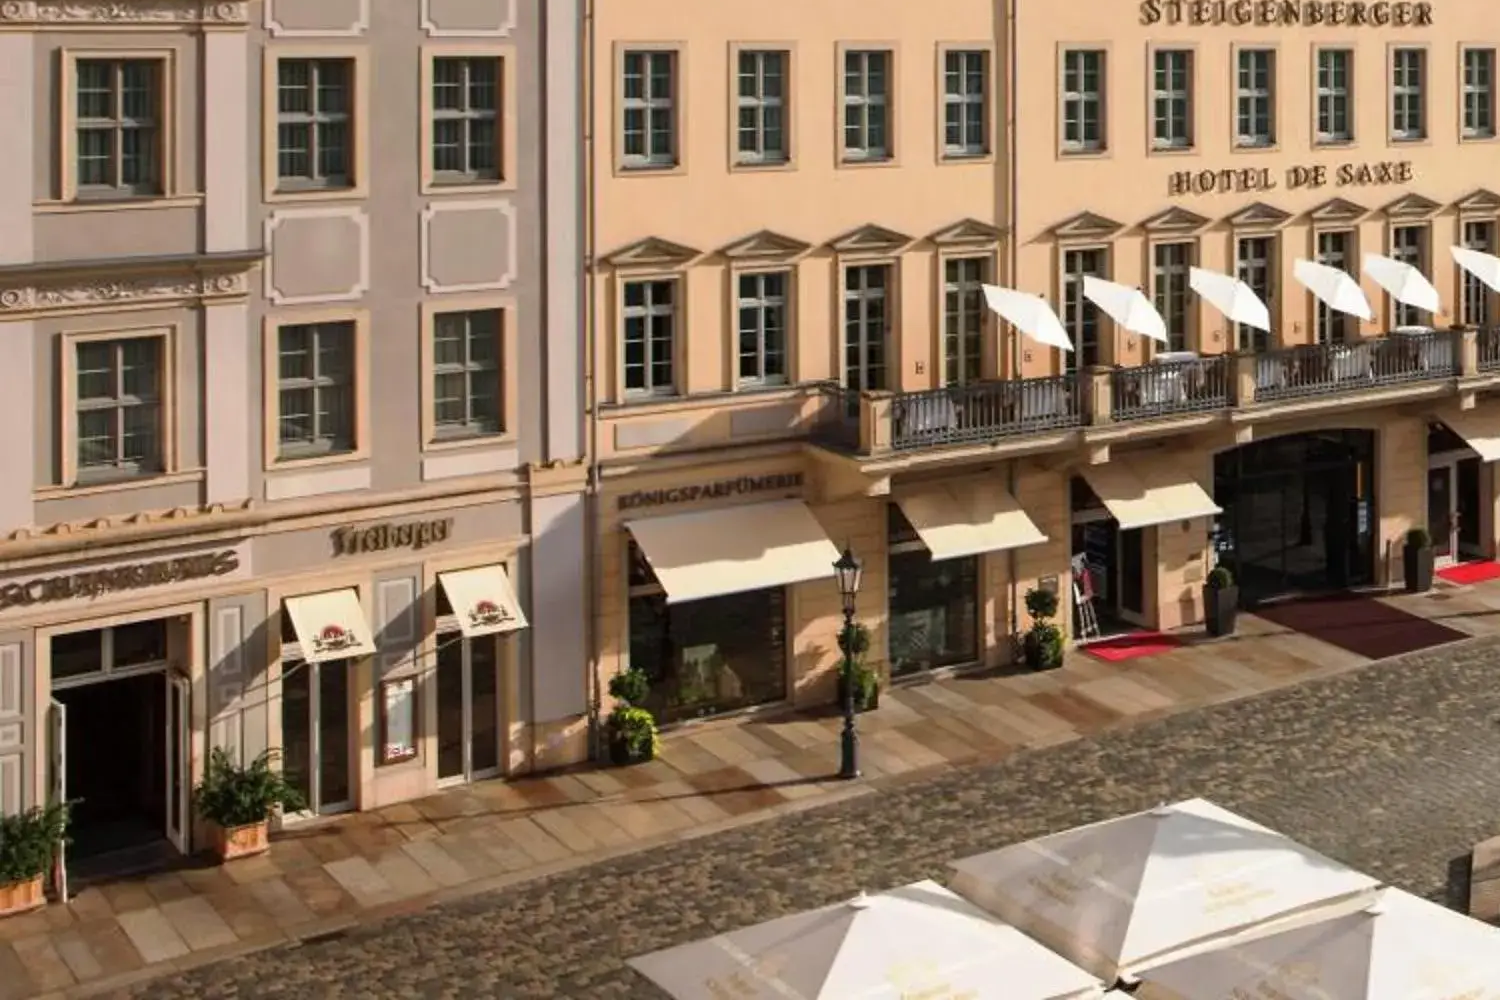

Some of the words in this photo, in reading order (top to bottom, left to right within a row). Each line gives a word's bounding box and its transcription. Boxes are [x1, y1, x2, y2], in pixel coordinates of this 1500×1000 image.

[1169, 166, 1276, 196] HOTEL
[1286, 165, 1328, 191] DE
[1336, 161, 1414, 187] SAXE
[617, 471, 804, 511] KÖNIGSPARFÜMERIE
[329, 517, 455, 558] Freiberger
